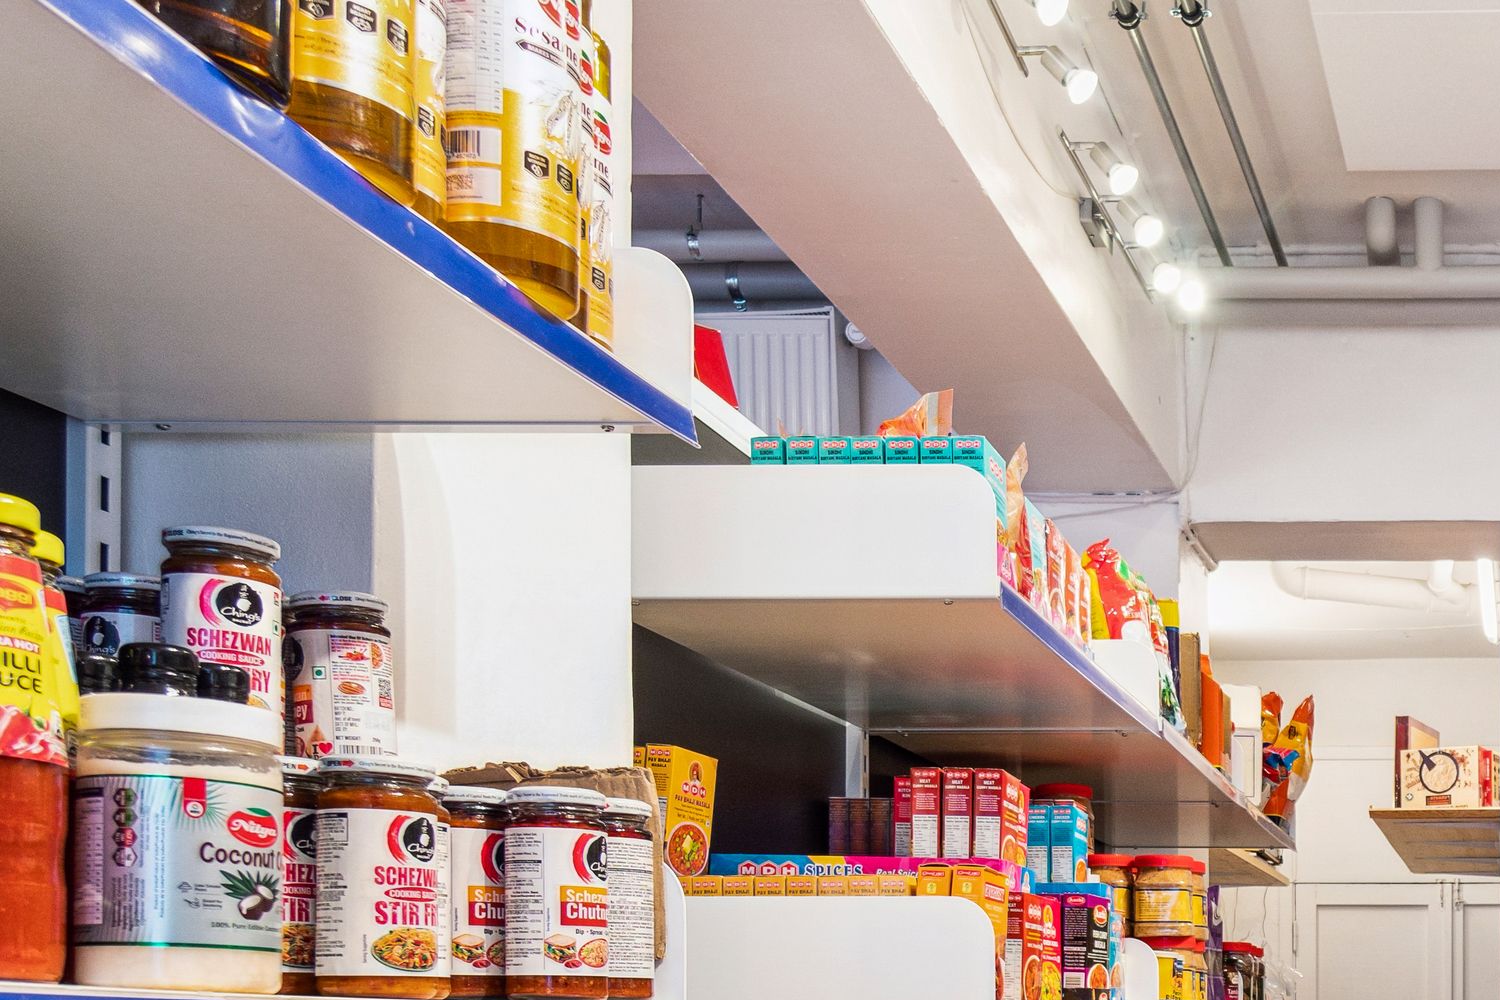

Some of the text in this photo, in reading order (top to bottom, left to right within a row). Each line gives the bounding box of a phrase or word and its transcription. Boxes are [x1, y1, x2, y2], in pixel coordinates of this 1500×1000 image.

[186, 627, 272, 657] SCHEZWAN
[682, 782, 706, 798] MDH
[200, 841, 274, 868] Coconut
[740, 864, 798, 876] MDH
[805, 864, 862, 876] SPICES
[374, 900, 420, 925] STIR
